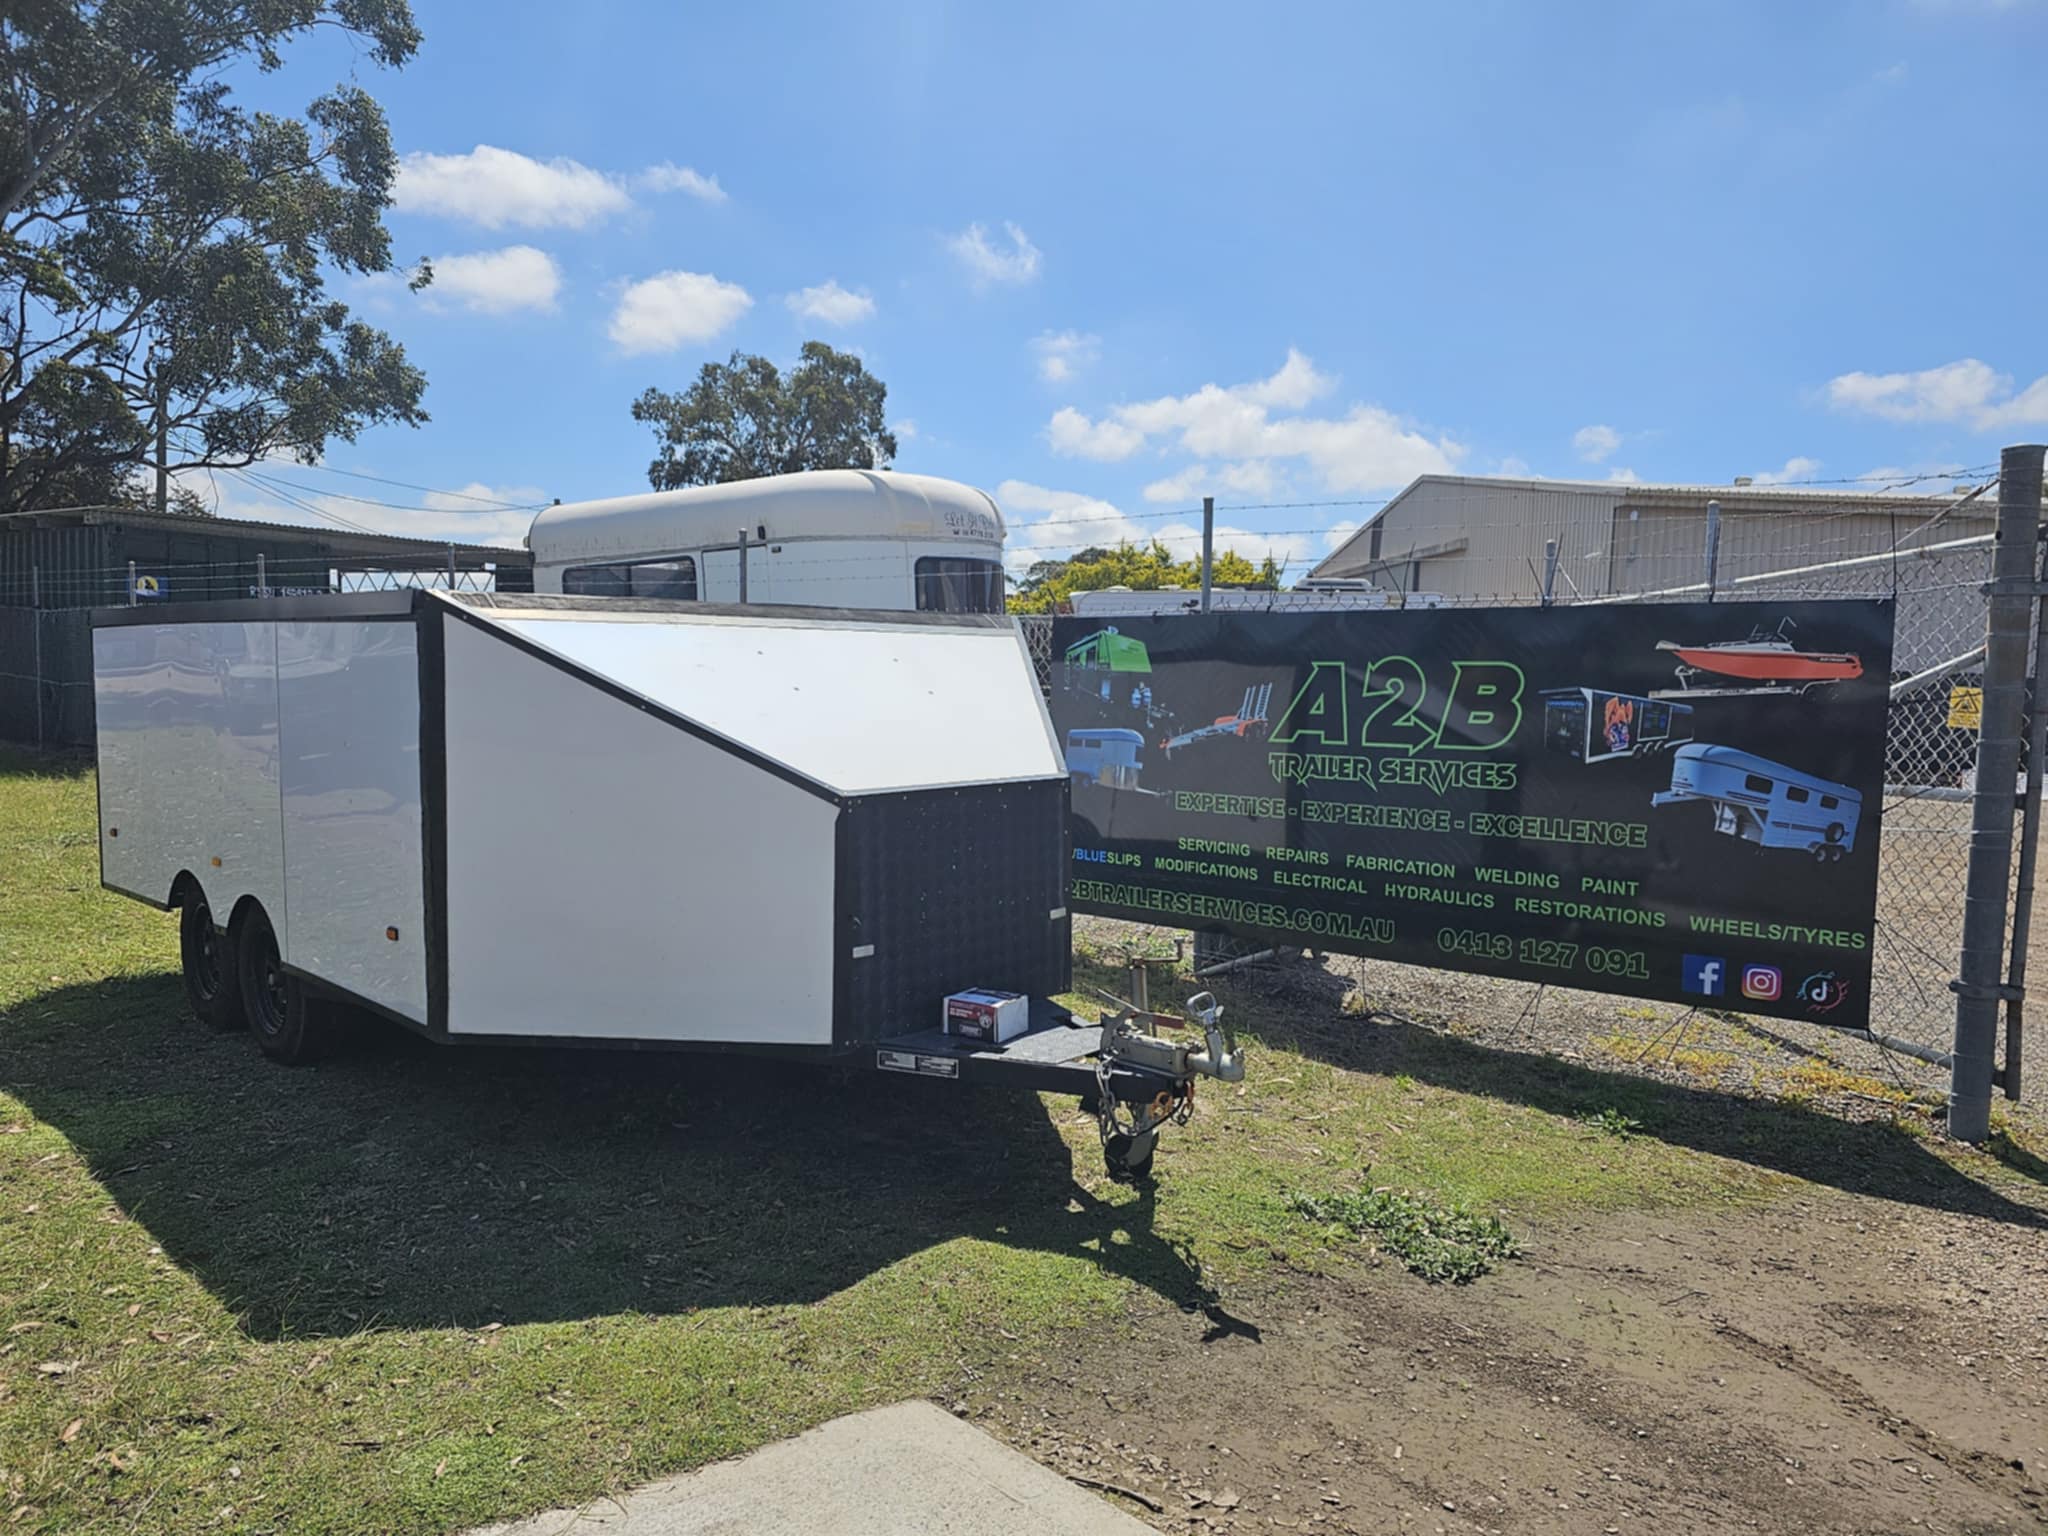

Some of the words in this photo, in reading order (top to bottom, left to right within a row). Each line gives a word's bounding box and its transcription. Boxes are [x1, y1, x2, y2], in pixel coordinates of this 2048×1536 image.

[1268, 655, 1525, 757] A2B
[1268, 752, 1378, 792] TRAILER
[1379, 757, 1517, 797] SERVICES
[1175, 791, 1286, 819] EXPERTISE
[1301, 800, 1450, 832] EXPERIENCE
[1469, 812, 1647, 848] EXCELLENCE
[1178, 837, 1250, 857] SERVICING
[1266, 847, 1329, 865] REPAIRS
[1346, 854, 1456, 878] FABRICATION
[1475, 867, 1560, 889] WELDING
[1582, 877, 1639, 897] PAINT
[1155, 857, 1258, 880] MODIFICATIONS
[1274, 871, 1367, 894] ELECTRICAL
[1385, 883, 1495, 909] HYDRAULICS
[1515, 898, 1666, 927] RESTORATIONS
[1689, 915, 1866, 949] WHEELS/TYRES
[1438, 928, 1512, 960] 0413
[1520, 937, 1579, 968] 127
[1586, 947, 1650, 979] 091
